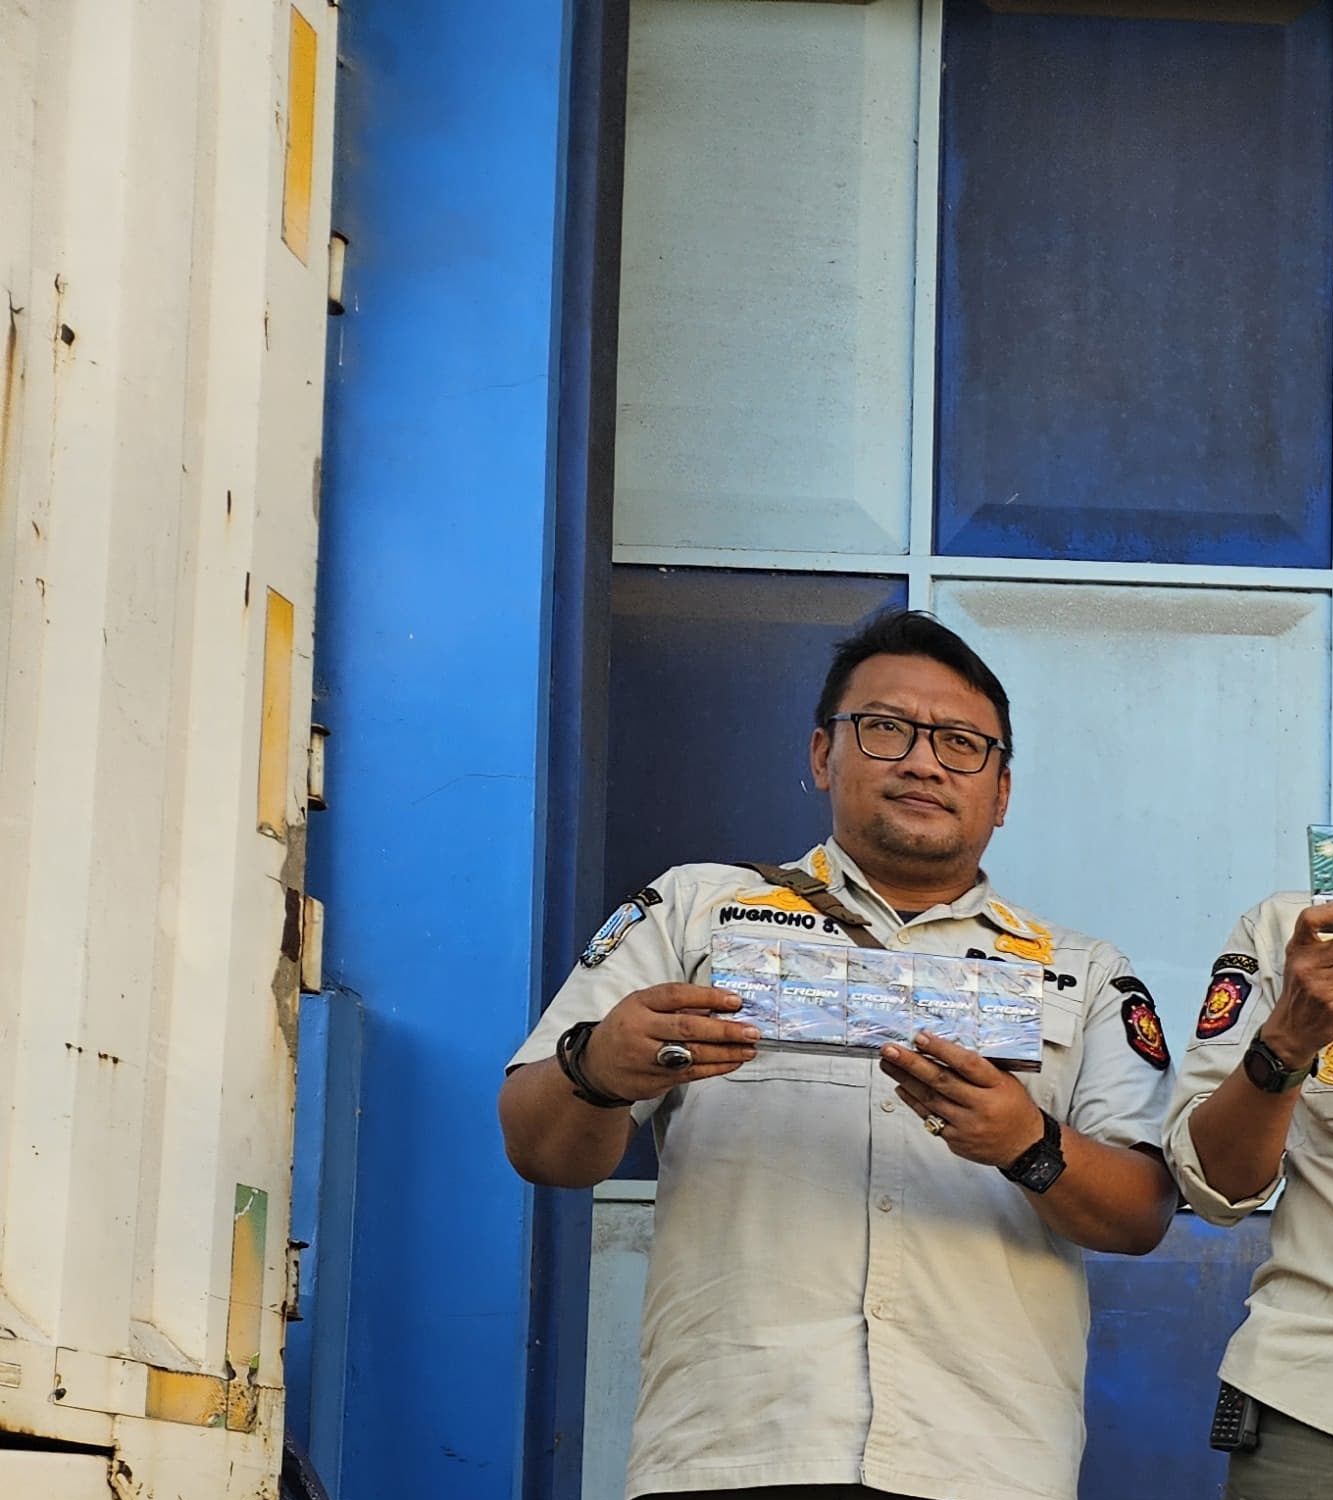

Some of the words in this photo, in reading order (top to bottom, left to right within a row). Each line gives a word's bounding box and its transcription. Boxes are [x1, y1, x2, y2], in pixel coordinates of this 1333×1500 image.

[719, 906, 816, 931] NUGROHO
[714, 979, 771, 993] CROWN
[783, 986, 839, 999] CROWN
[983, 1005, 1037, 1016] CROWN
